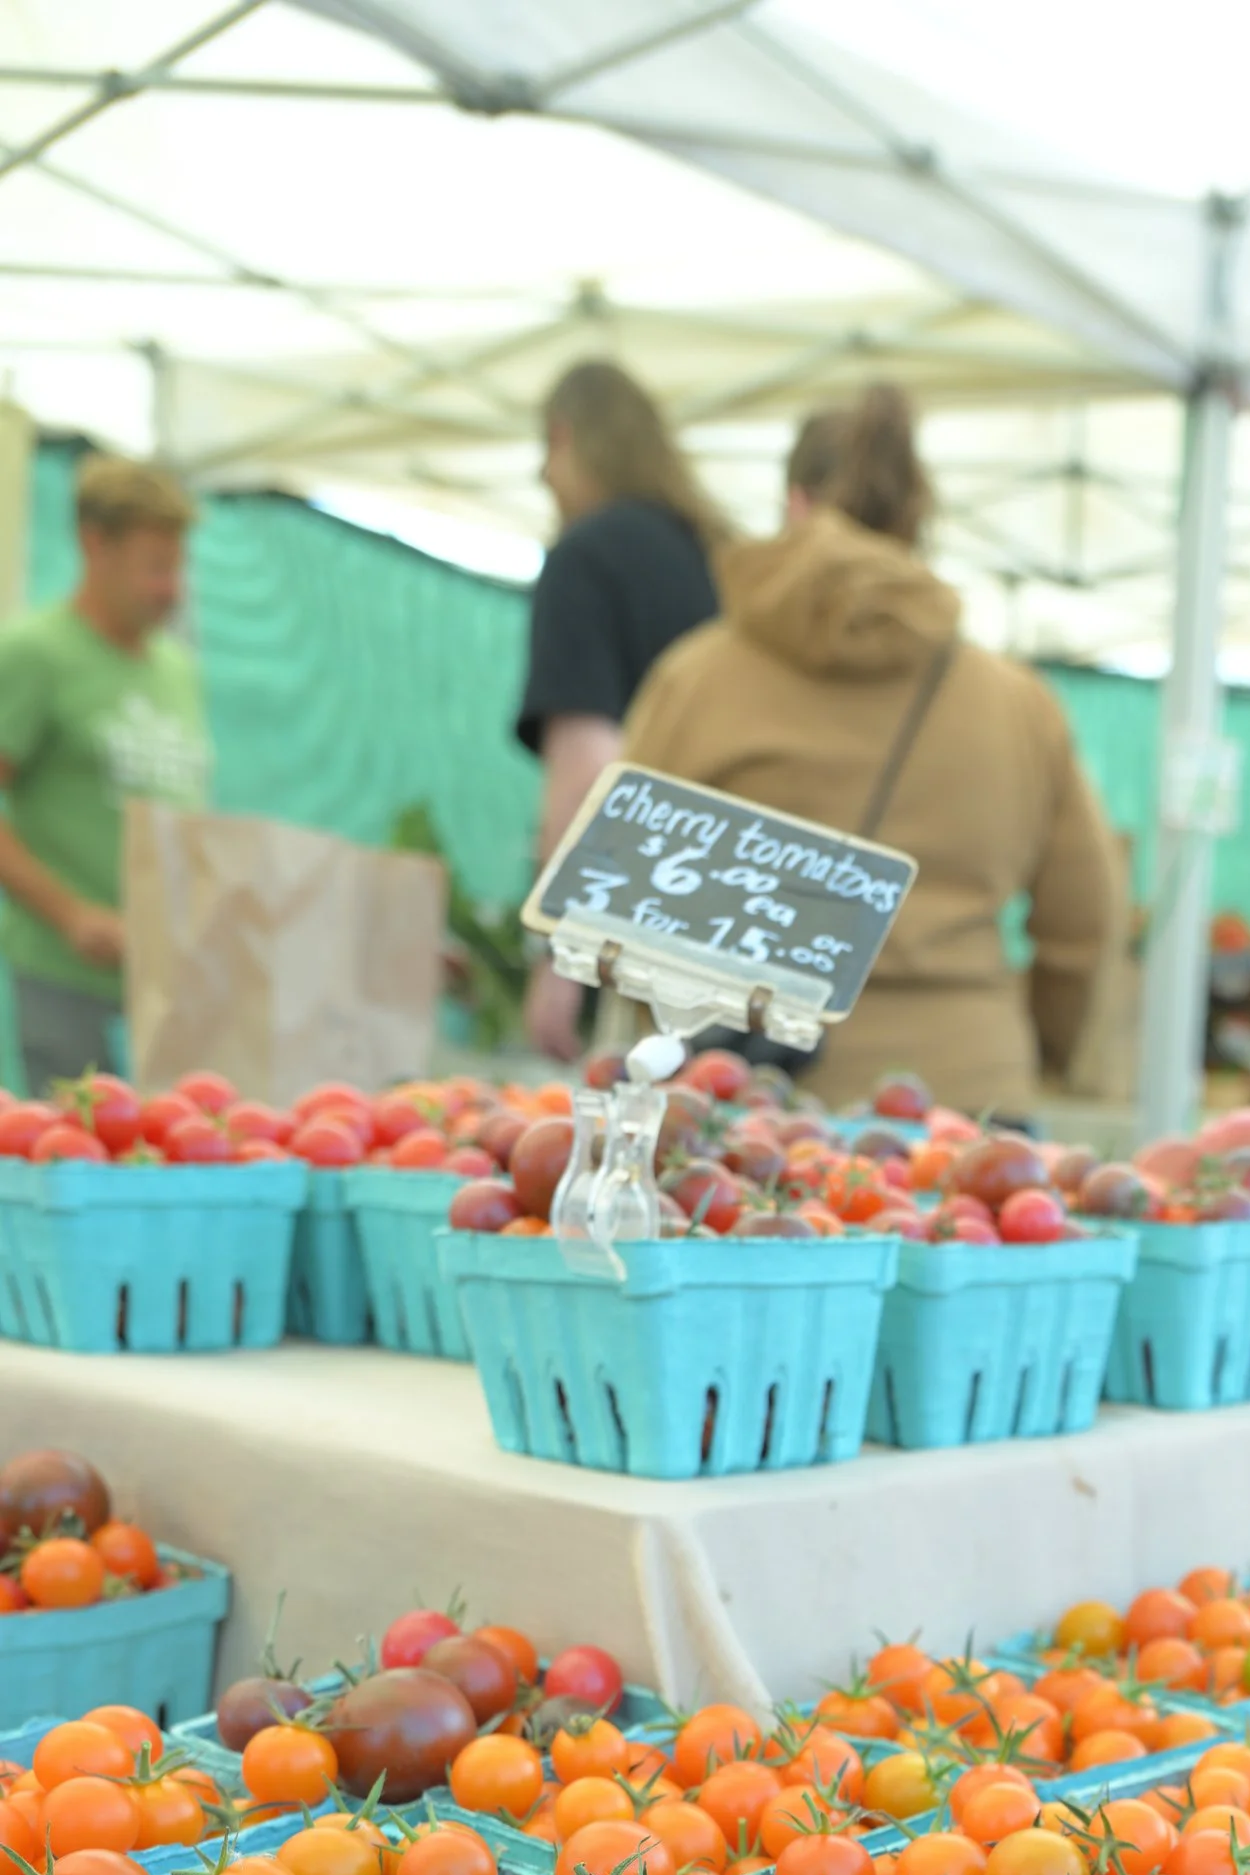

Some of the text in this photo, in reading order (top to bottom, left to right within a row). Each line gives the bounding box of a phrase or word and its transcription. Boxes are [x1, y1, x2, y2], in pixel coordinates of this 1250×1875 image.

[734, 819, 902, 912] tomatoes
[565, 867, 629, 913] 3
[632, 897, 689, 935] for
[743, 895, 853, 957] ea or
